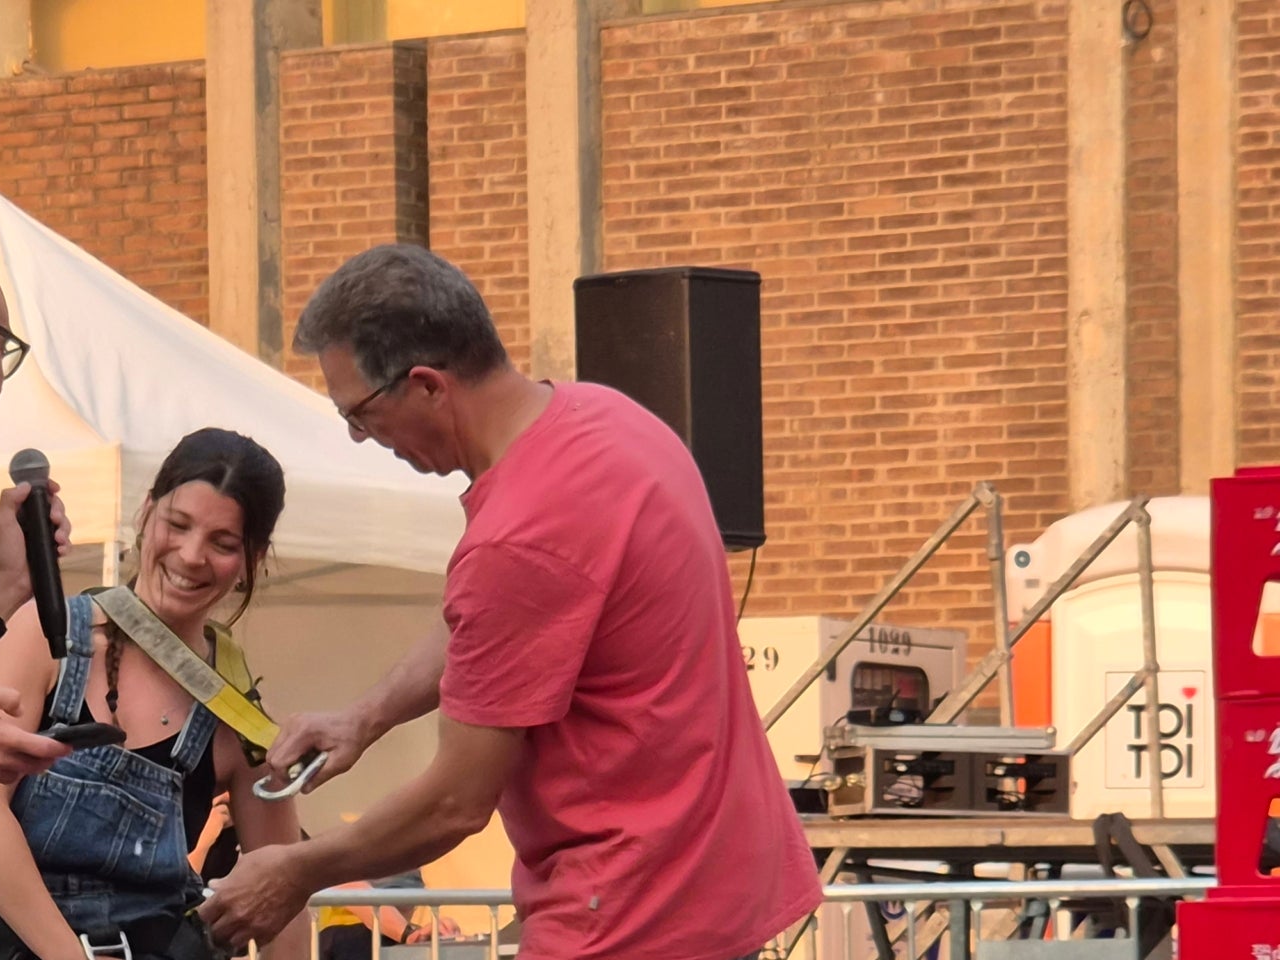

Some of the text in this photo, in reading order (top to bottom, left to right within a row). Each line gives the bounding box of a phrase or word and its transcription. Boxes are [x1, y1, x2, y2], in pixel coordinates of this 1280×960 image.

[868, 627, 911, 656] 1029
[1126, 703, 1193, 739] TOI
[1126, 743, 1193, 780] TOI
